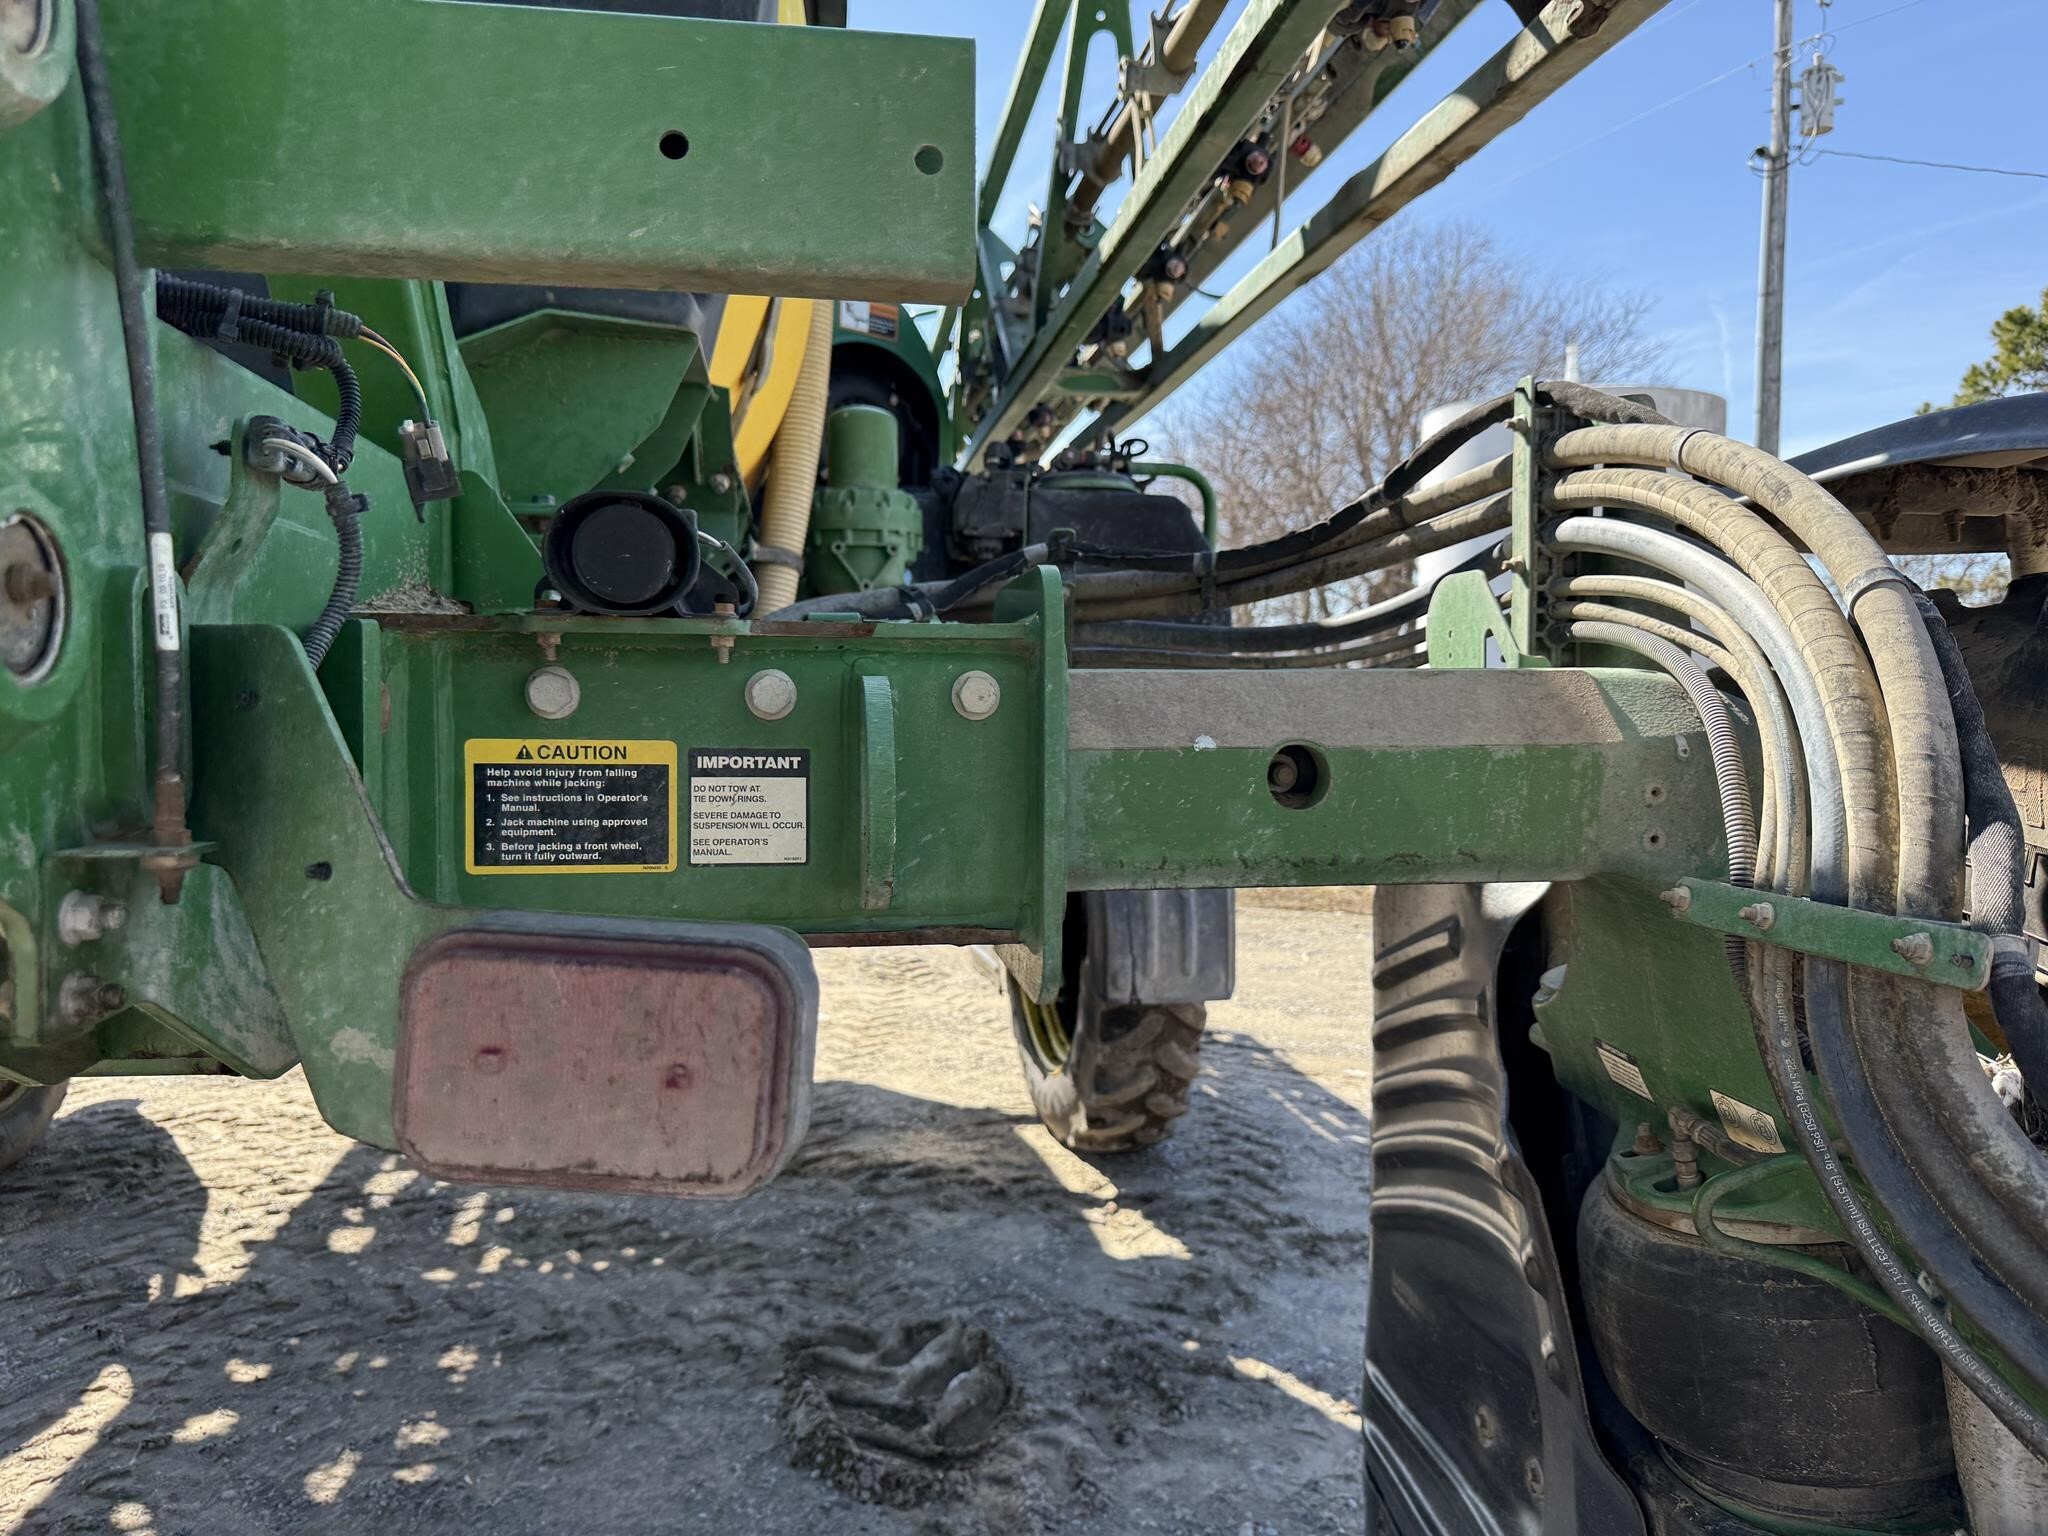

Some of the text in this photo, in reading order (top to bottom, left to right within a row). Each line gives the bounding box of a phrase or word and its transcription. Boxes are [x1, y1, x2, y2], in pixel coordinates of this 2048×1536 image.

[537, 745, 627, 760] CAUTION
[697, 756, 801, 769] IMPORTANT
[487, 768, 638, 778] Help avoid injury from falling
[487, 779, 605, 788] machine while jacking:
[487, 794, 648, 803] 1. See instructions in Operator's
[693, 795, 767, 803] TIE DOWN RINGS.
[501, 804, 540, 812] Manual.
[486, 818, 648, 827] 2. Jack machine using approved
[501, 828, 557, 838] equipment.
[486, 843, 495, 851] 3.
[501, 842, 534, 851] Before
[537, 842, 573, 852] jacking
[584, 842, 608, 850] front
[611, 842, 642, 851] wheel,
[692, 838, 769, 846] SEE OPERATOR'S
[501, 852, 602, 862] turn it fully outward.
[692, 848, 732, 856] MANUAL.
[1785, 1058, 1799, 1079] 22.5
[1791, 1080, 1804, 1101] MPa
[1856, 1217, 1872, 1236] ISO
[1866, 1236, 1893, 1267] 11237
[1908, 1293, 1925, 1314] SAE
